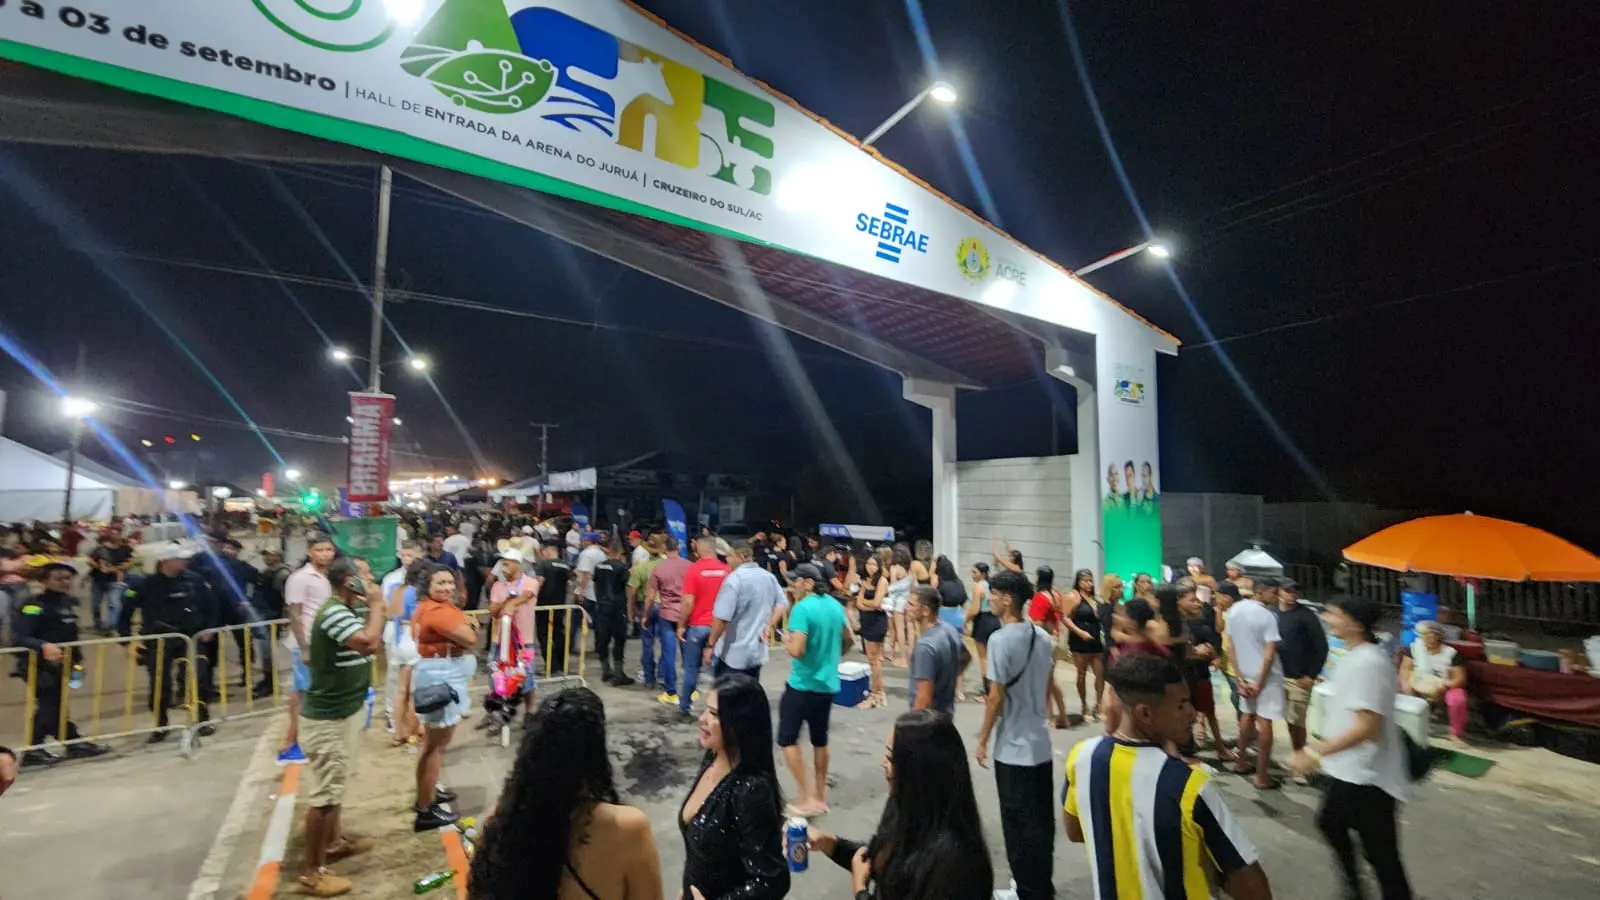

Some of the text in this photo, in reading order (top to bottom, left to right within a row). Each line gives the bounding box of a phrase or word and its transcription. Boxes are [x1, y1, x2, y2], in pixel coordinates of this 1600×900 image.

[20, 0, 763, 222] a 03 de setembro HALL DE ENTRADA DA ARENA DO JURUÁ CRUZEIRO DO SUL/AC
[855, 212, 929, 254] SEBRAE
[995, 263, 1027, 288] ACRE
[349, 403, 382, 495] BRAHMA
